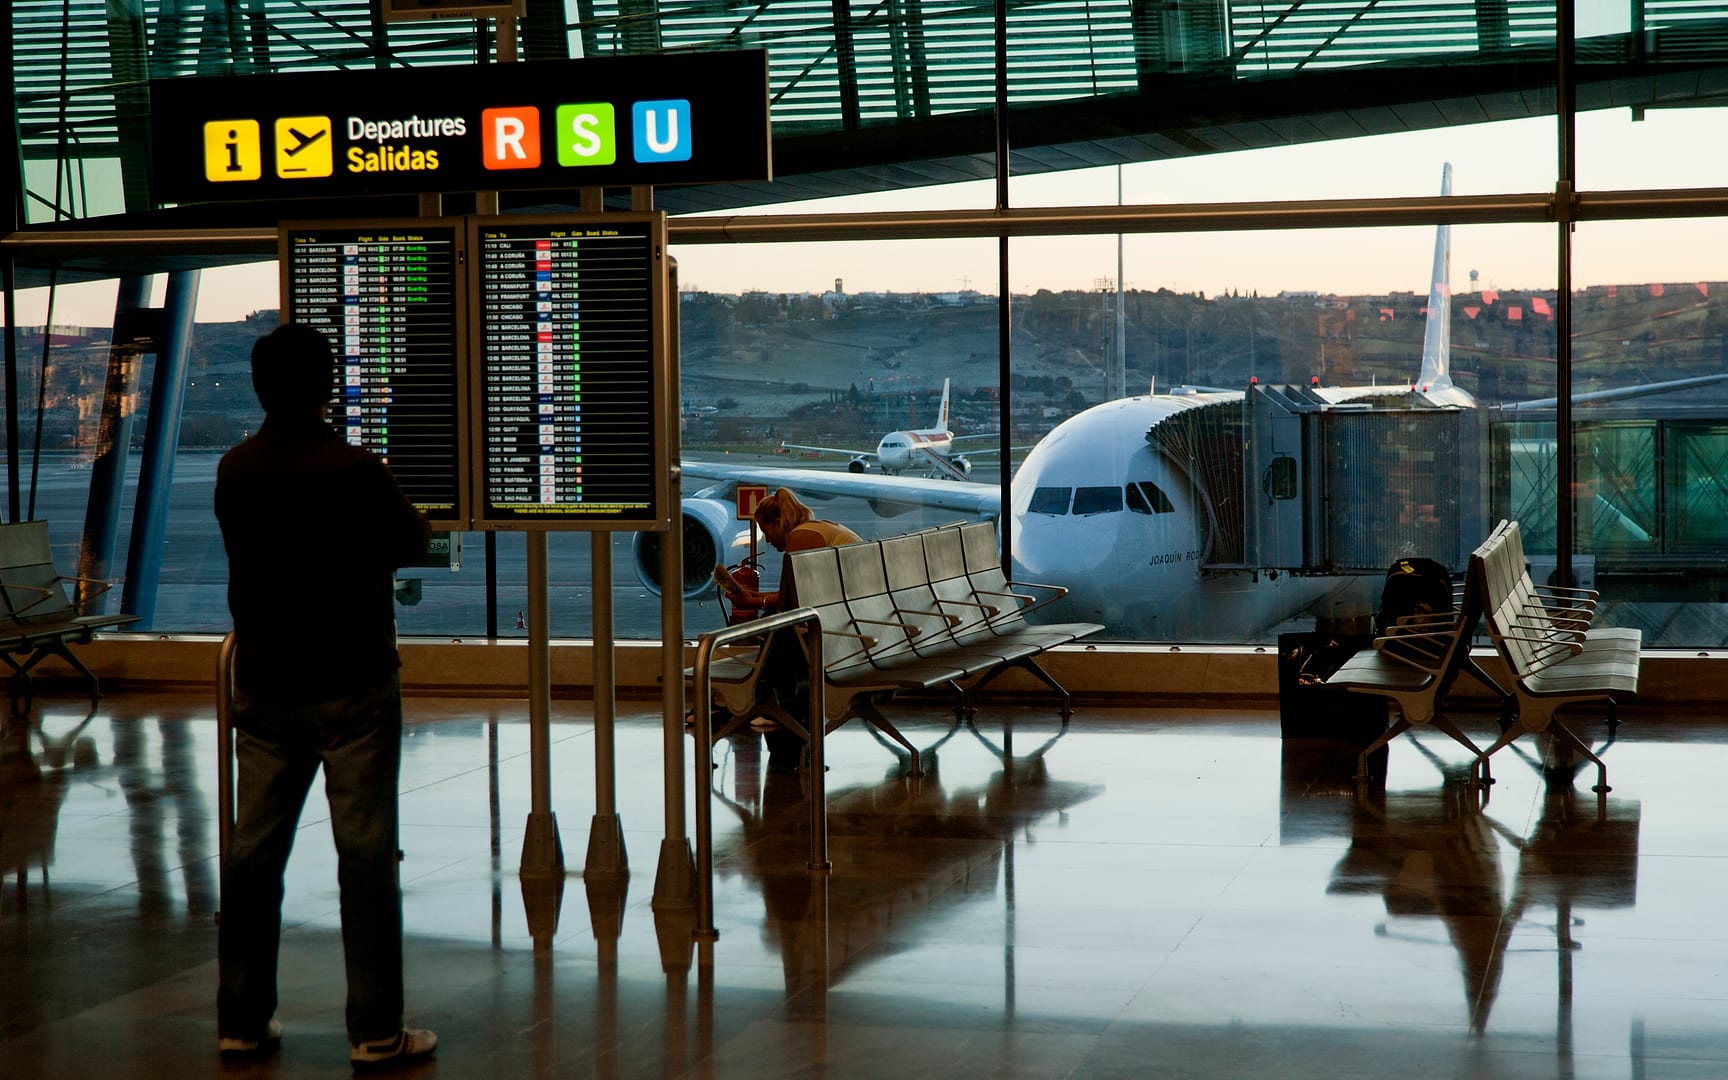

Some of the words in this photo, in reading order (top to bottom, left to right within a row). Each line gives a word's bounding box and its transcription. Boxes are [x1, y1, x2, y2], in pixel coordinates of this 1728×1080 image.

[347, 115, 466, 144] Departures
[495, 117, 527, 160] R
[571, 113, 602, 156] S
[645, 109, 678, 153] U
[347, 146, 440, 174] Salidas
